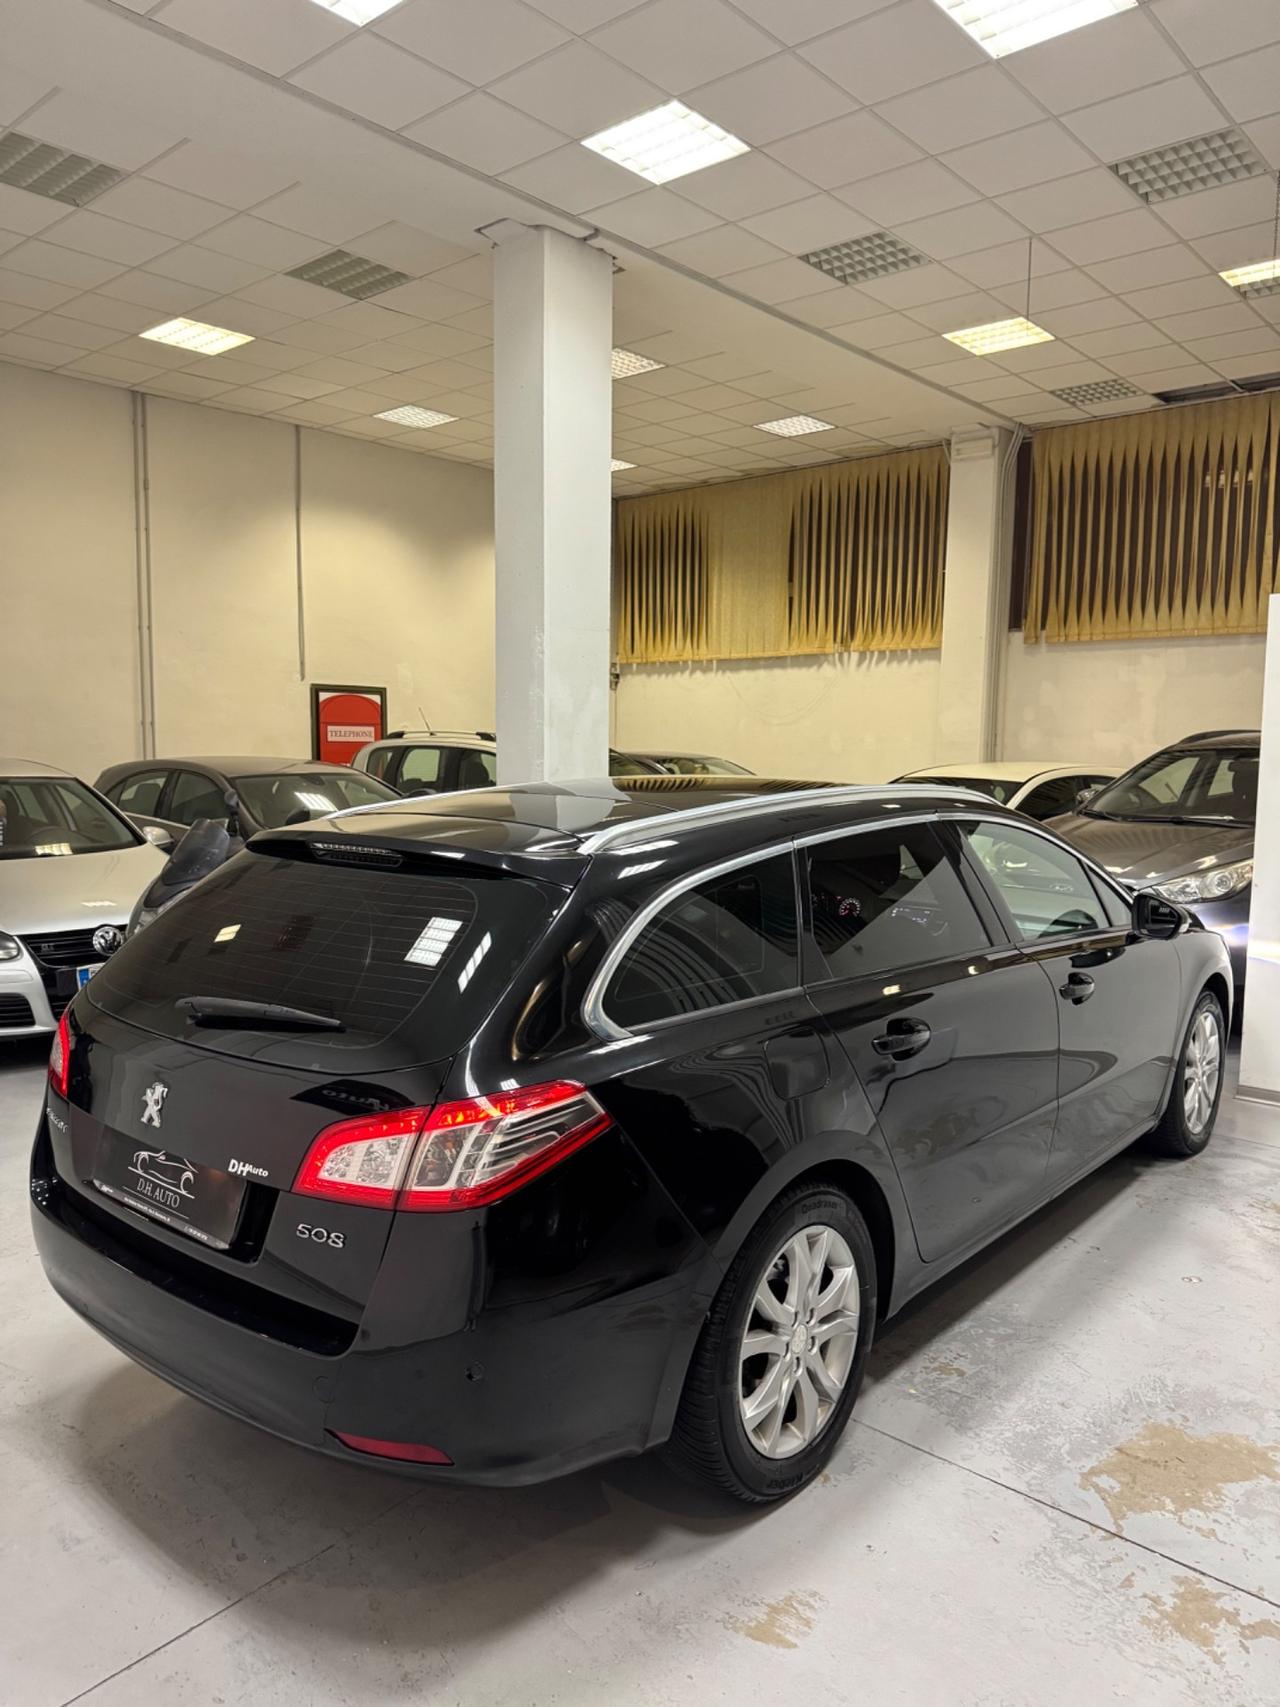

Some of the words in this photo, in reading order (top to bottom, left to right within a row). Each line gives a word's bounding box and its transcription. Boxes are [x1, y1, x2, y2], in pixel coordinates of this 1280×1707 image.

[329, 730, 373, 738] TELEPHONE
[154, 1188, 181, 1208] AUTO
[296, 1223, 345, 1248] 508
